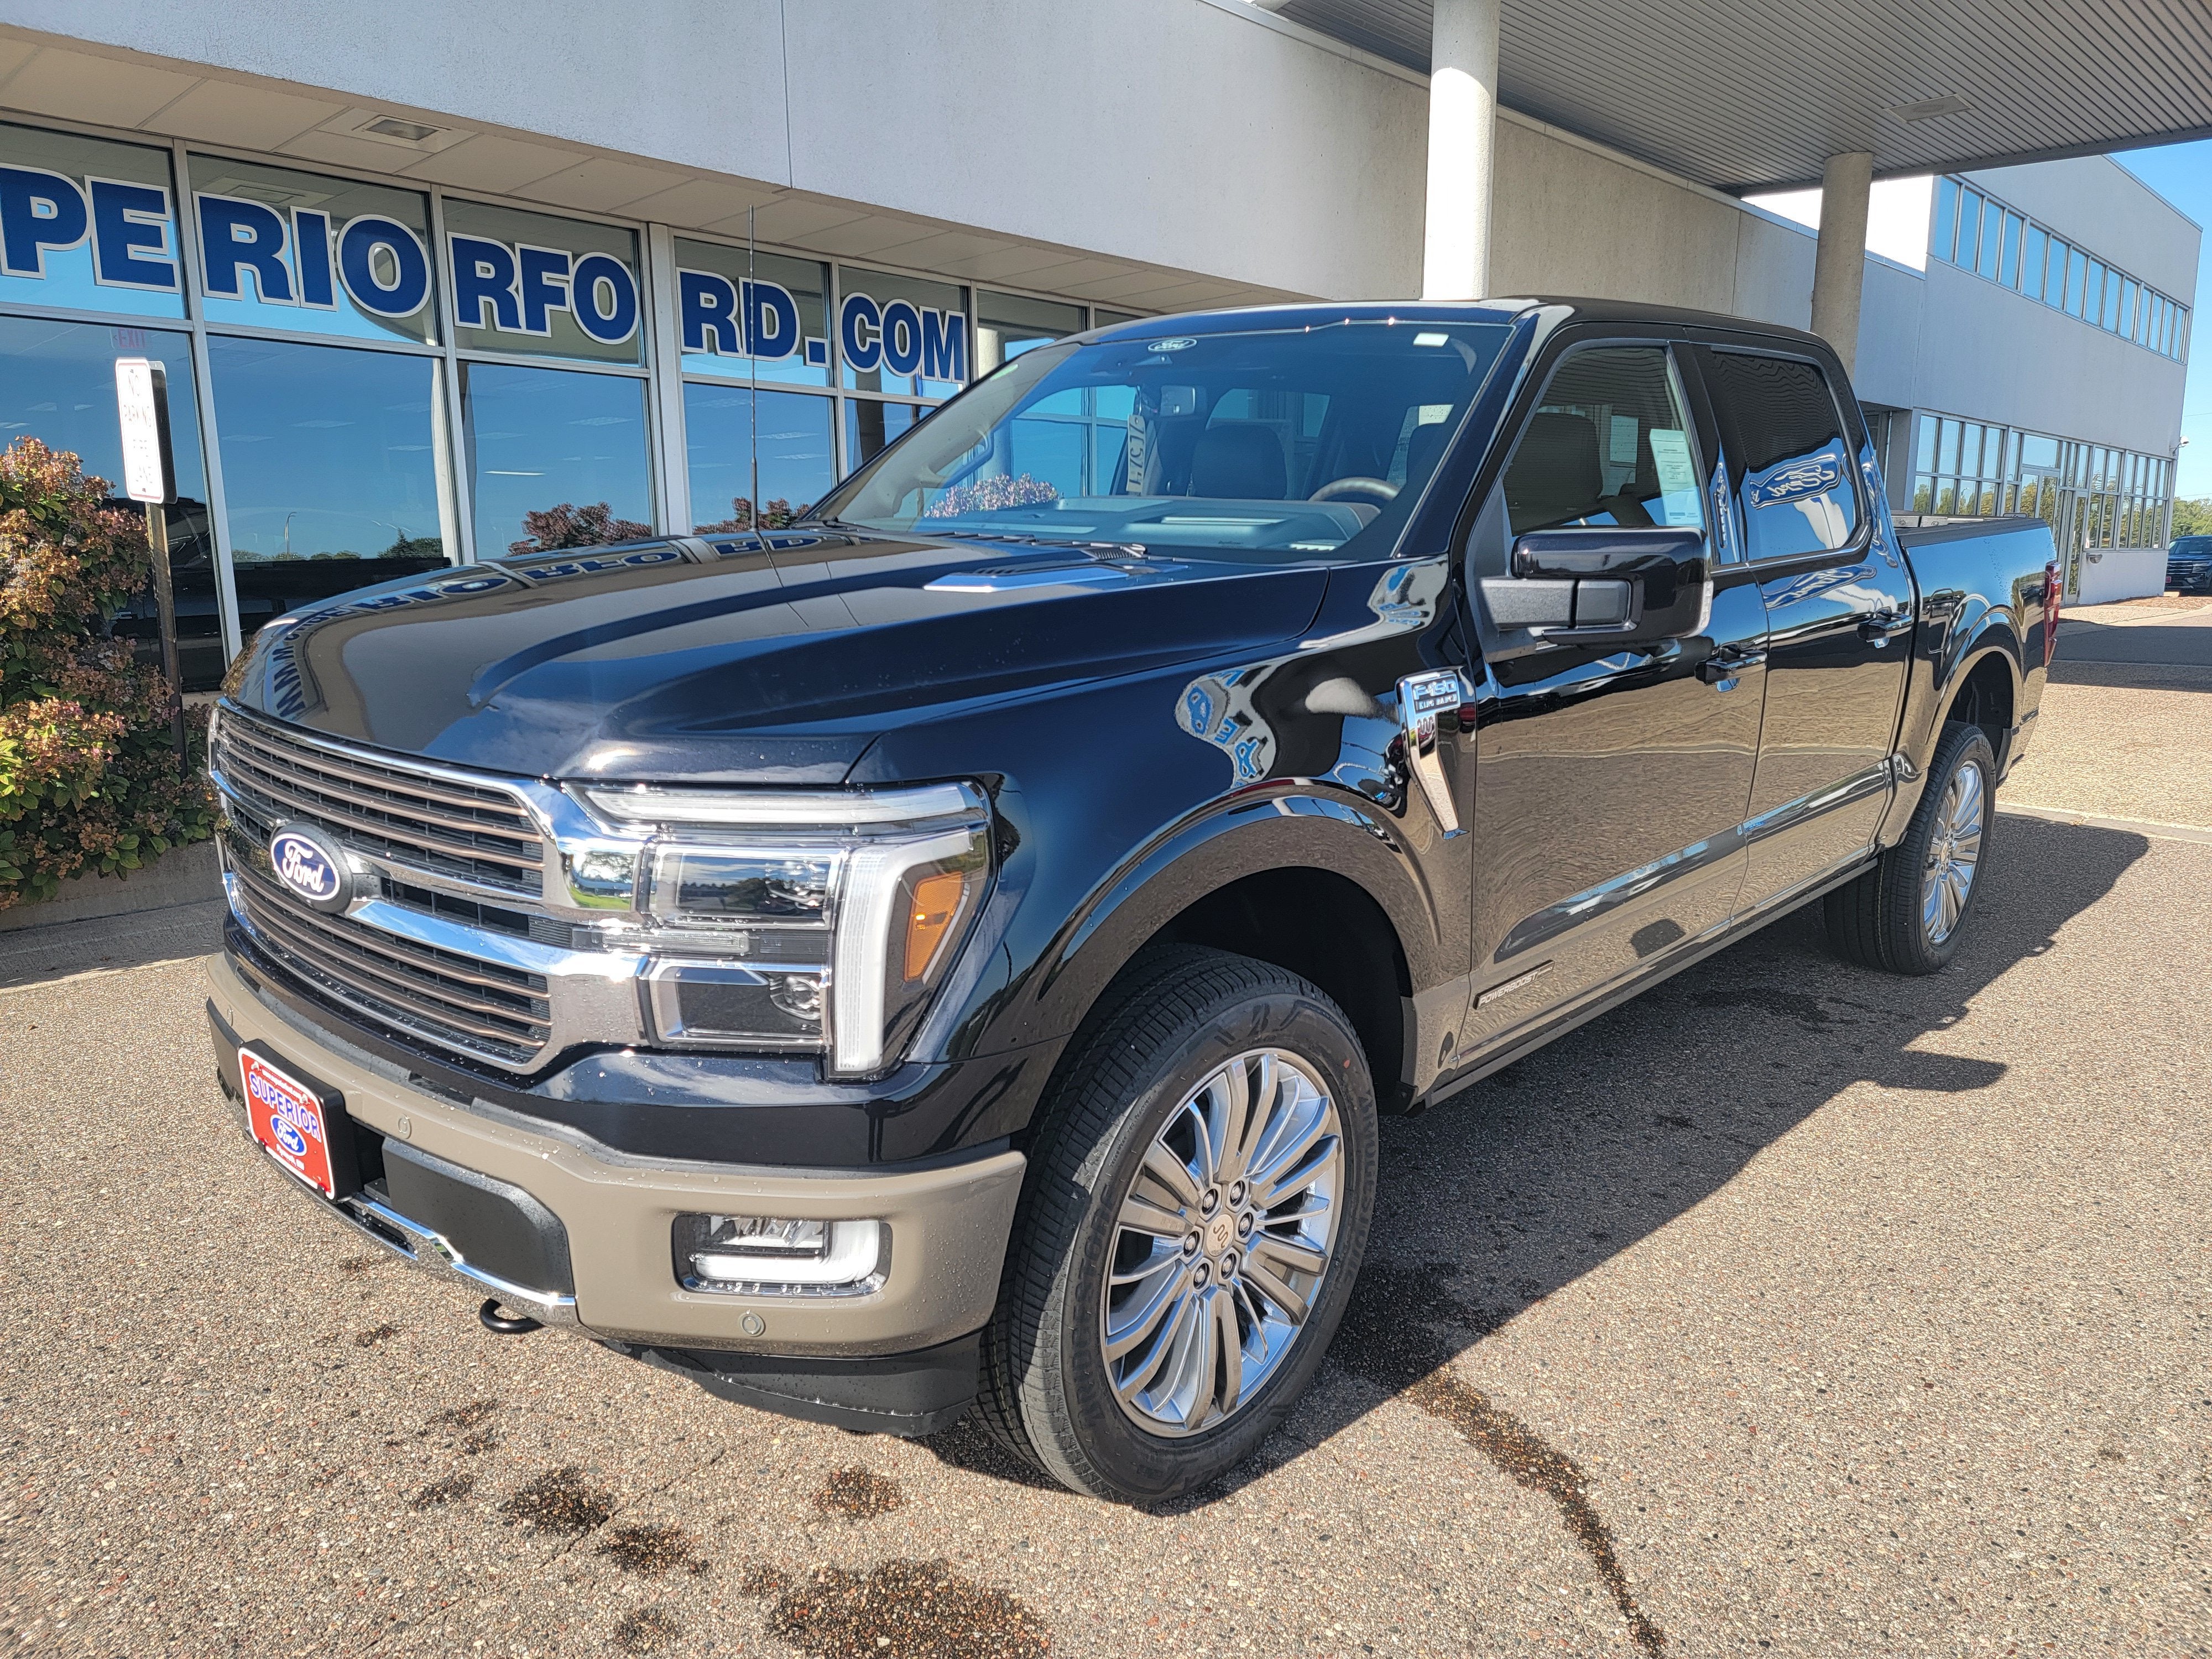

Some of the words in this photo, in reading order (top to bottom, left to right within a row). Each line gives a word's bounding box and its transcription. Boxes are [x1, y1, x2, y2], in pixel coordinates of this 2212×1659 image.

[282, 840, 325, 893] Ford
[1479, 971, 1538, 1007] POWERBOOST
[249, 1071, 322, 1143] SUPERIOR
[277, 1119, 299, 1151] Ford
